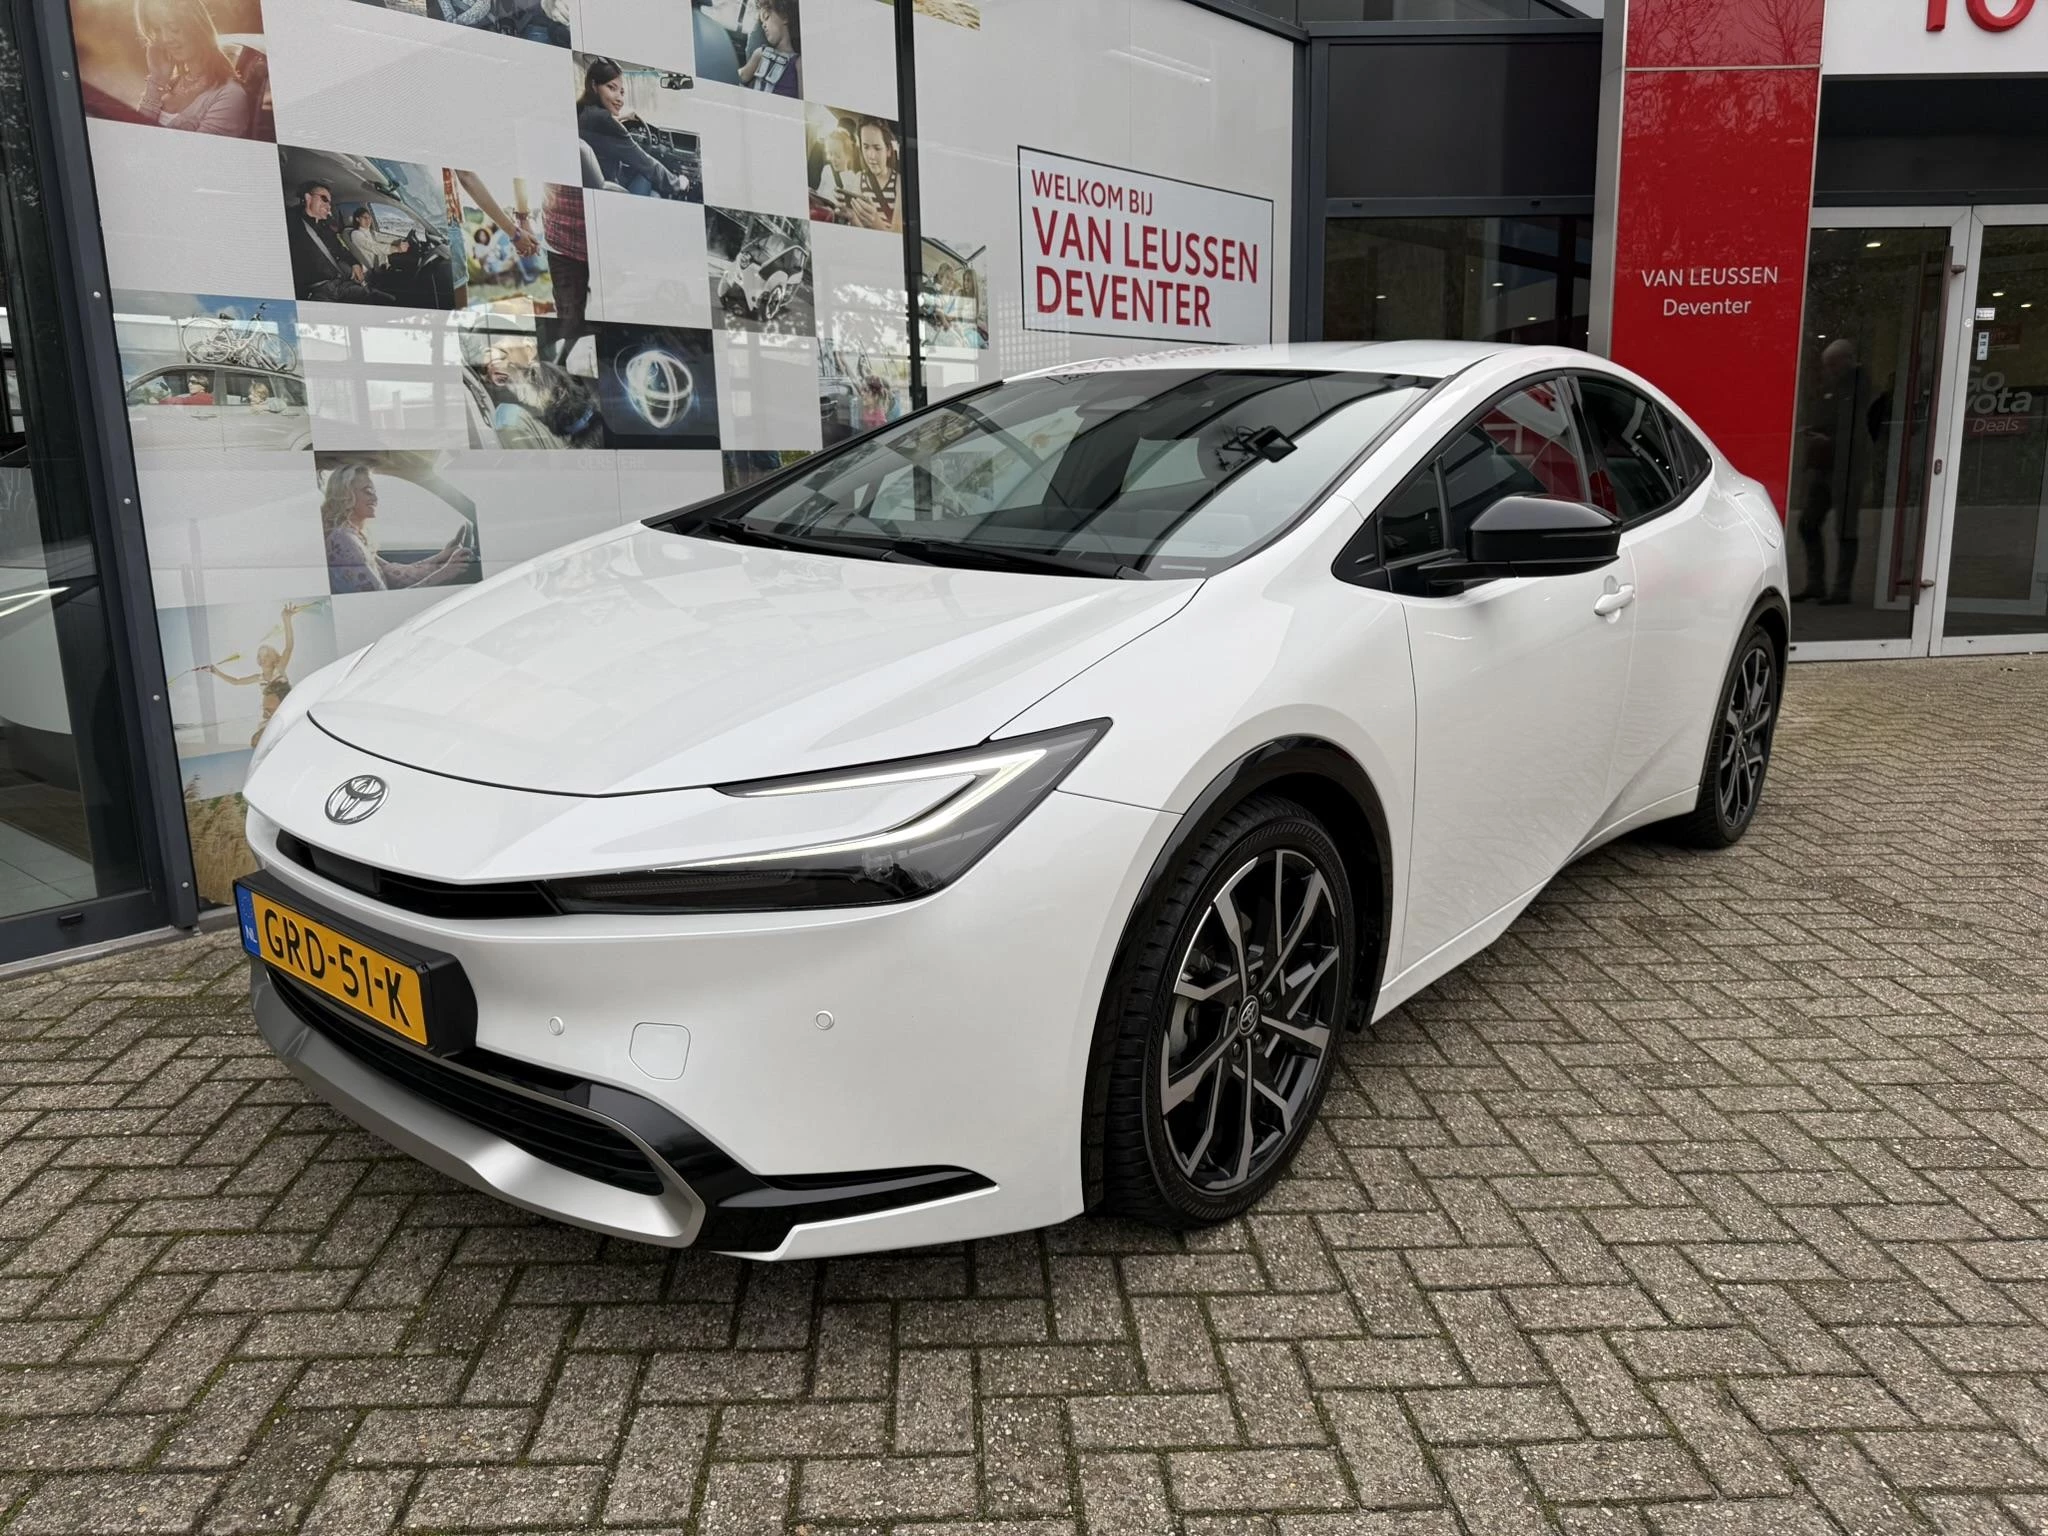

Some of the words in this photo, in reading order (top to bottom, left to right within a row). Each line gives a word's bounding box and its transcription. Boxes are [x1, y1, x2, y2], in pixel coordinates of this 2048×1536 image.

[1031, 169, 1123, 211] WELKOM
[1129, 189, 1153, 216] BIJ
[1031, 206, 1111, 265] VAN
[1124, 222, 1258, 284] LEUSSEN
[1641, 268, 1683, 287] VAN
[1689, 266, 1778, 286] LEUSSEN
[1036, 265, 1212, 328] DEVENTER
[1663, 298, 1752, 316] Deventer
[1972, 416, 2020, 432] Deals
[245, 925, 258, 943] NL
[264, 908, 411, 1028] GRD-51-K
